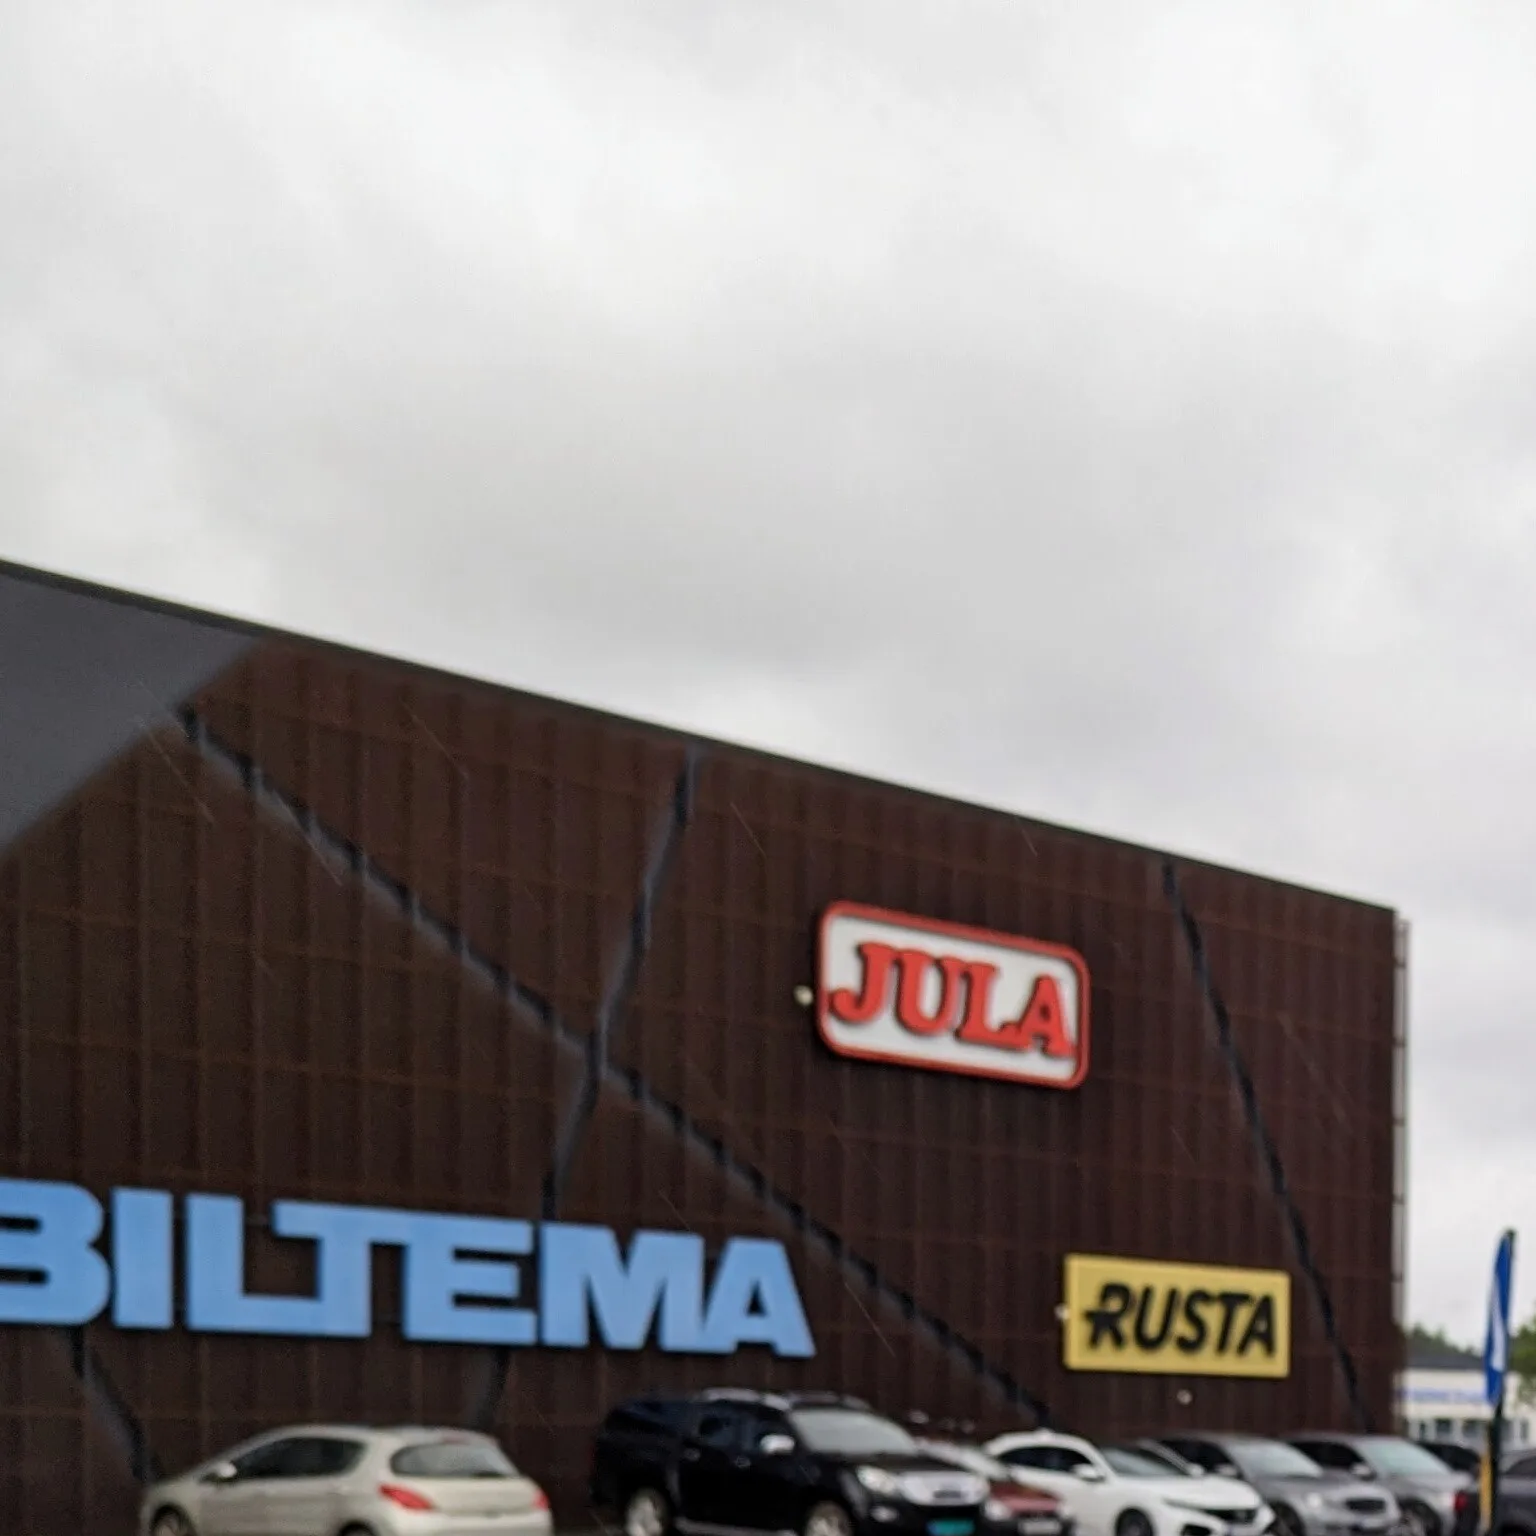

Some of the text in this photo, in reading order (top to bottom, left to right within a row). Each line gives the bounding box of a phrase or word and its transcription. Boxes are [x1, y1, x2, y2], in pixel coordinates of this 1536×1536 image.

[829, 942, 1077, 1060] JULA
[0, 1178, 815, 1358] BILTEMA
[1084, 1282, 1279, 1356] RUSTA
